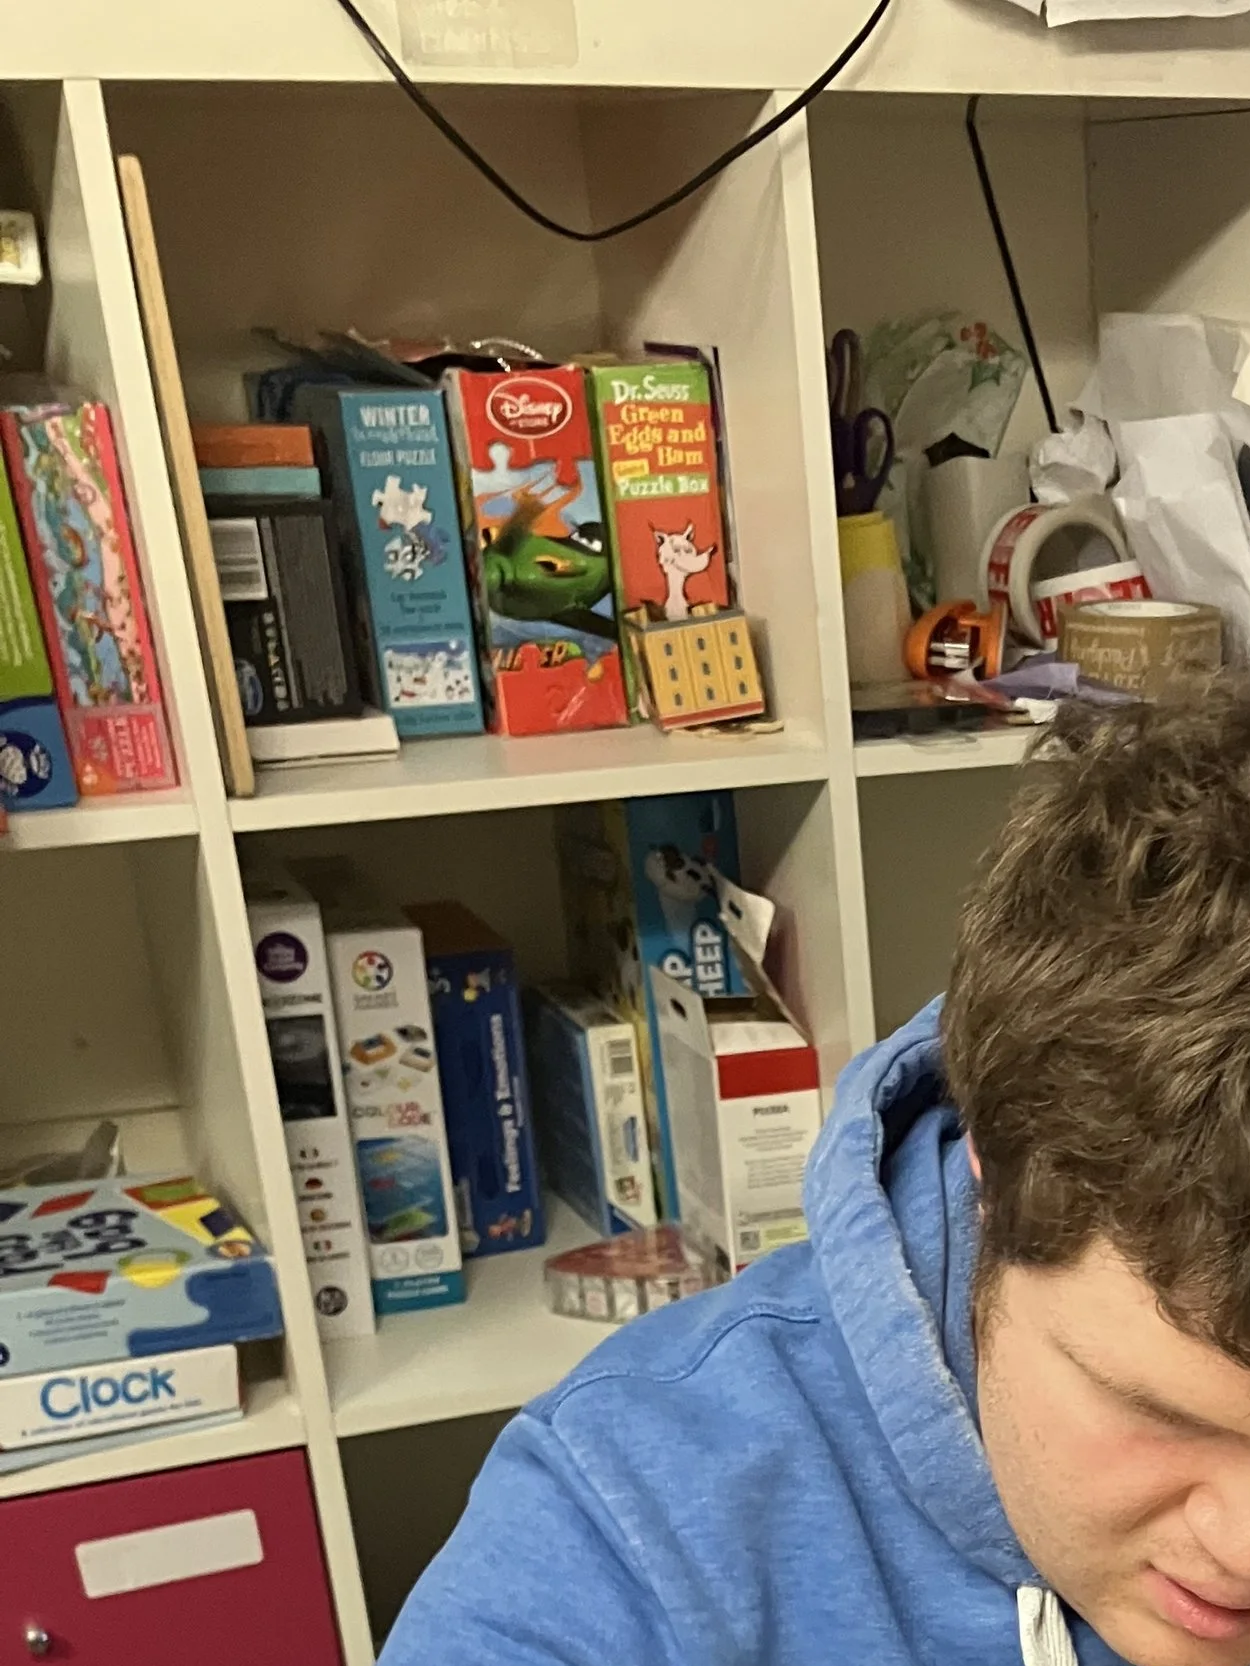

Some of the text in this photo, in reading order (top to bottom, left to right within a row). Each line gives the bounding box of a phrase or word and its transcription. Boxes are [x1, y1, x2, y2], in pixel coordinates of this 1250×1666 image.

[611, 375, 690, 404] Dr. Seuss
[360, 404, 430, 427] WINTER
[494, 391, 564, 423] Disney
[620, 404, 684, 425] Green
[608, 421, 706, 455] Eggs and
[657, 447, 704, 467] Ham
[618, 475, 710, 497] Puzzle Box
[40, 1367, 177, 1421] Clock
